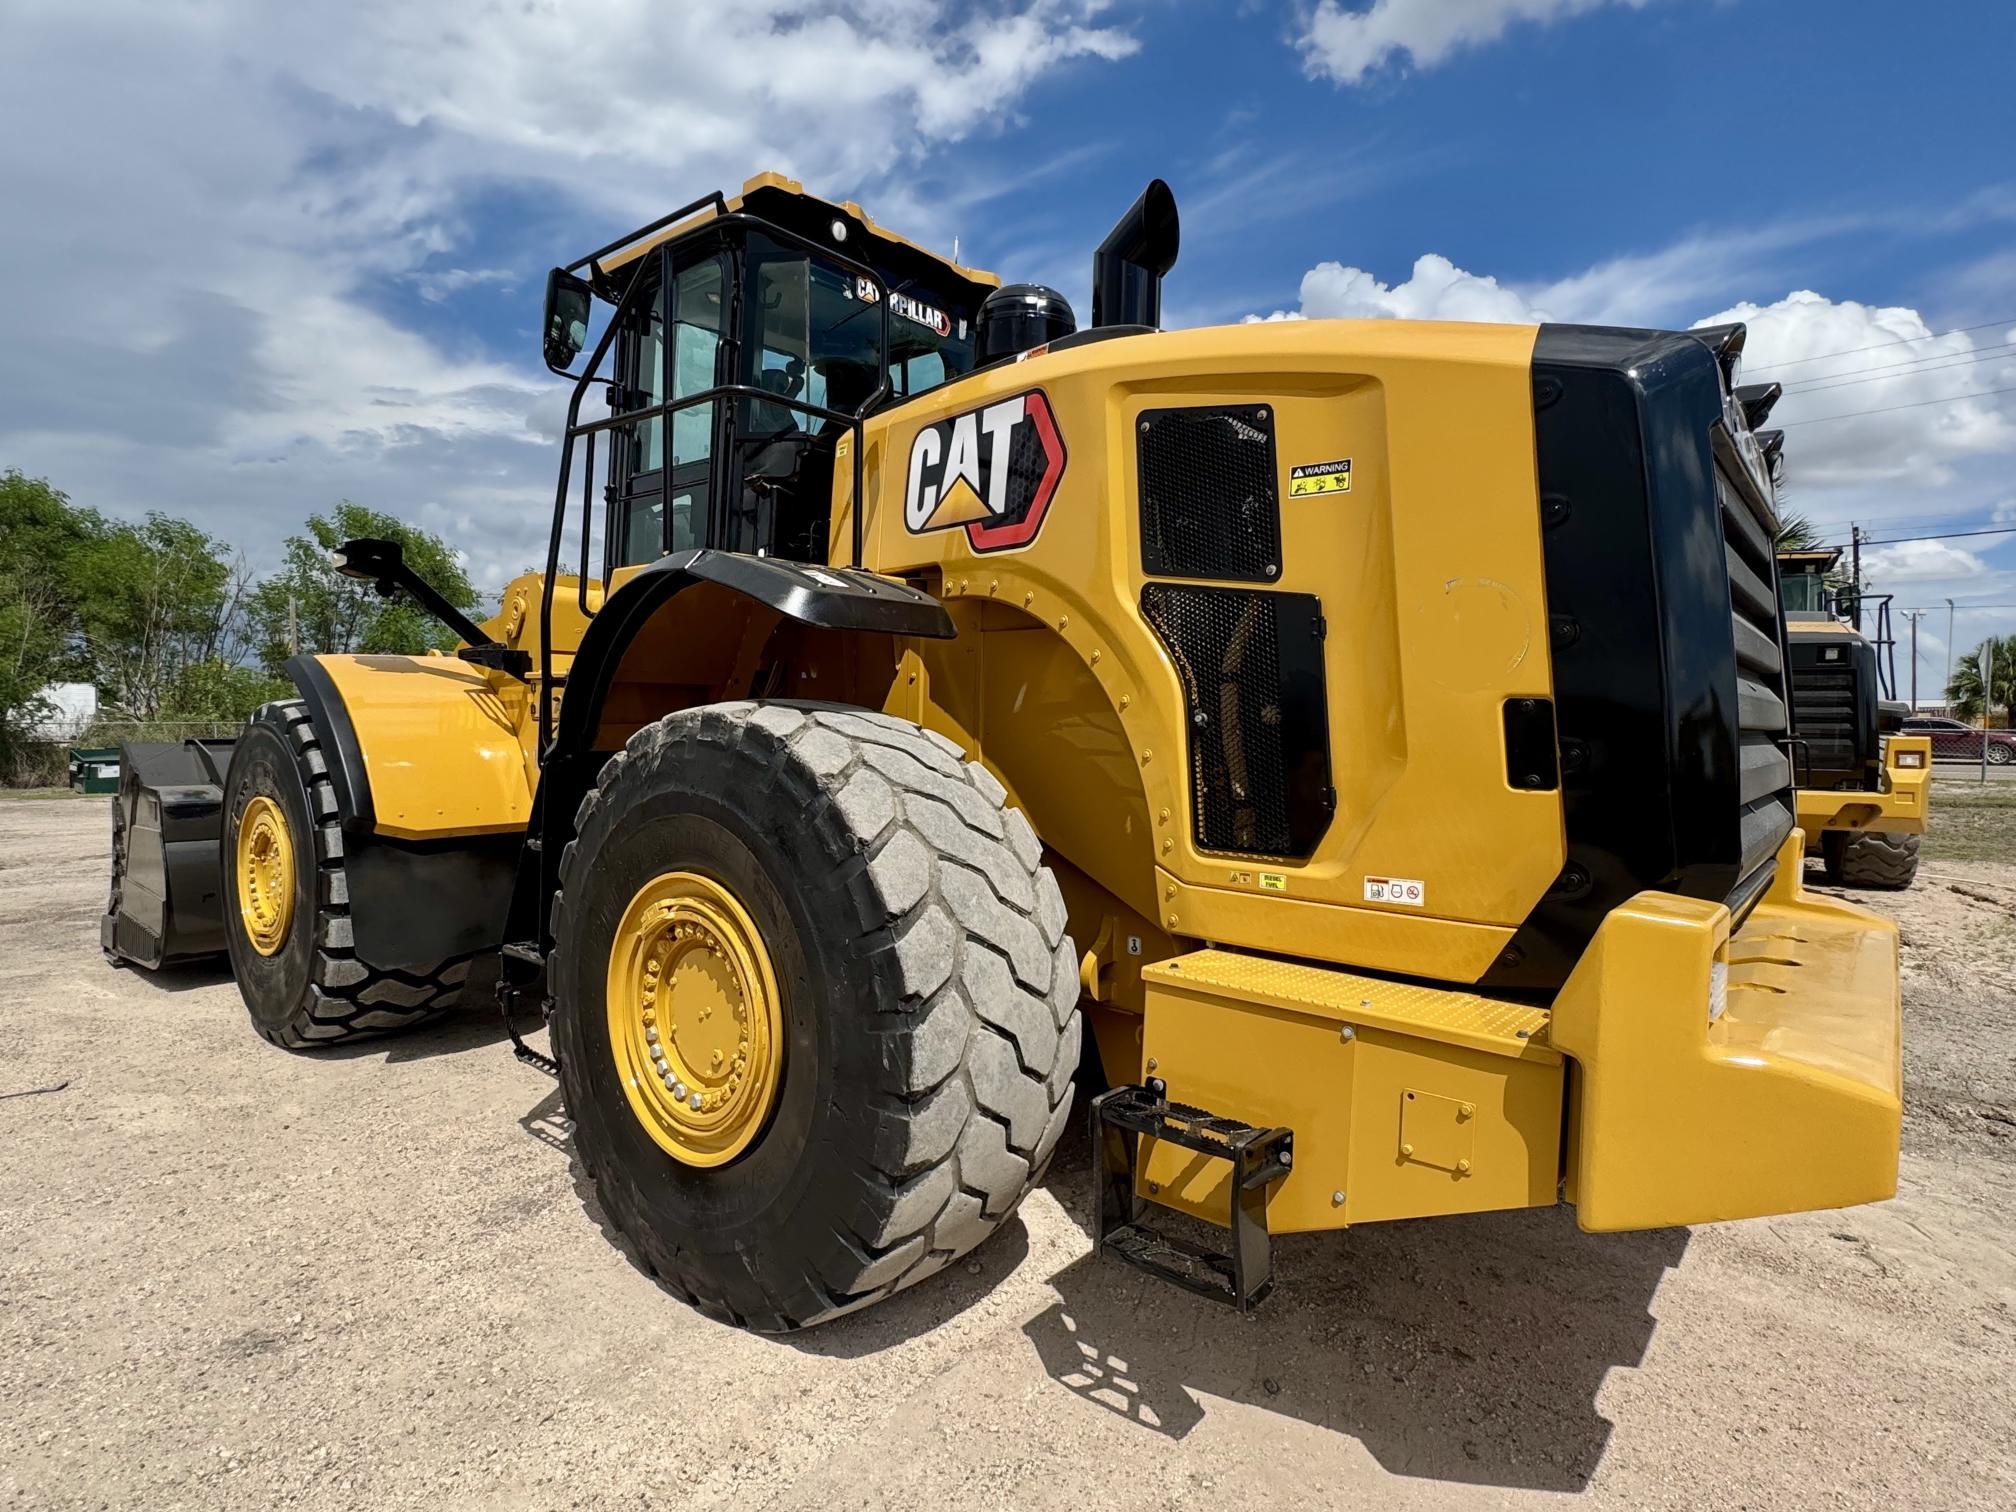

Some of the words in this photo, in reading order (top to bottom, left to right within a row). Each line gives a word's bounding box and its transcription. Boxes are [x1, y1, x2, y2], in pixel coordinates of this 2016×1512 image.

[857, 278, 943, 330] CATRPILLAR
[906, 396, 1025, 531] CAT
[1305, 462, 1348, 475] WARNING
